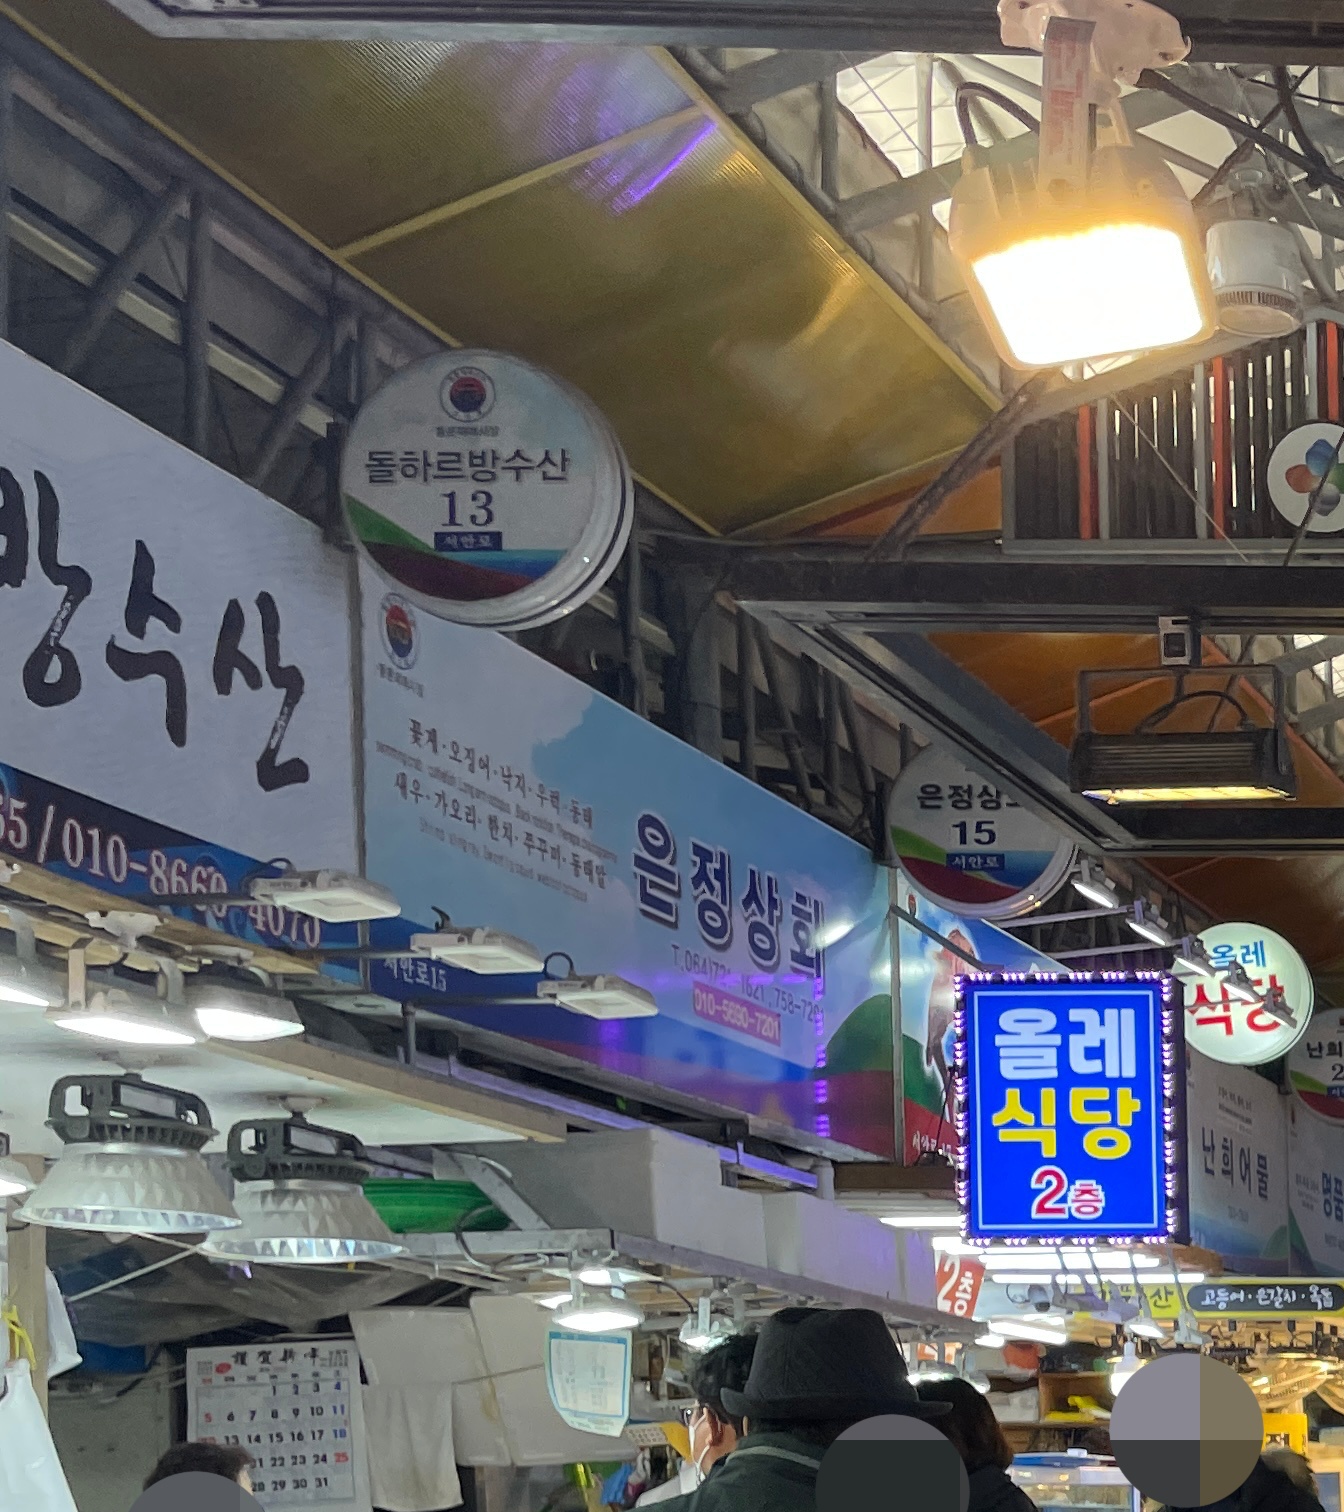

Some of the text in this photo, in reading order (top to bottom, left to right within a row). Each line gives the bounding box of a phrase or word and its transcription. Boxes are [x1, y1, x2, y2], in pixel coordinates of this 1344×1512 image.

[365, 449, 571, 484] 돌하르방수산
[441, 490, 494, 527] 13
[951, 820, 996, 845] 15
[633, 812, 825, 980] 은정상회
[1211, 941, 1267, 969] 올레
[1187, 974, 1287, 1036] 식당
[994, 1007, 1136, 1080] 올레
[991, 1087, 1141, 1159] 식당
[1202, 1126, 1269, 1201] 난희어물
[1030, 1165, 1106, 1219] 2층
[309, 1405, 325, 1417] 10
[331, 1403, 346, 1416] 11
[247, 1433, 262, 1445] 14
[268, 1432, 284, 1444] 15
[289, 1431, 305, 1443] 16
[310, 1429, 325, 1441] 17
